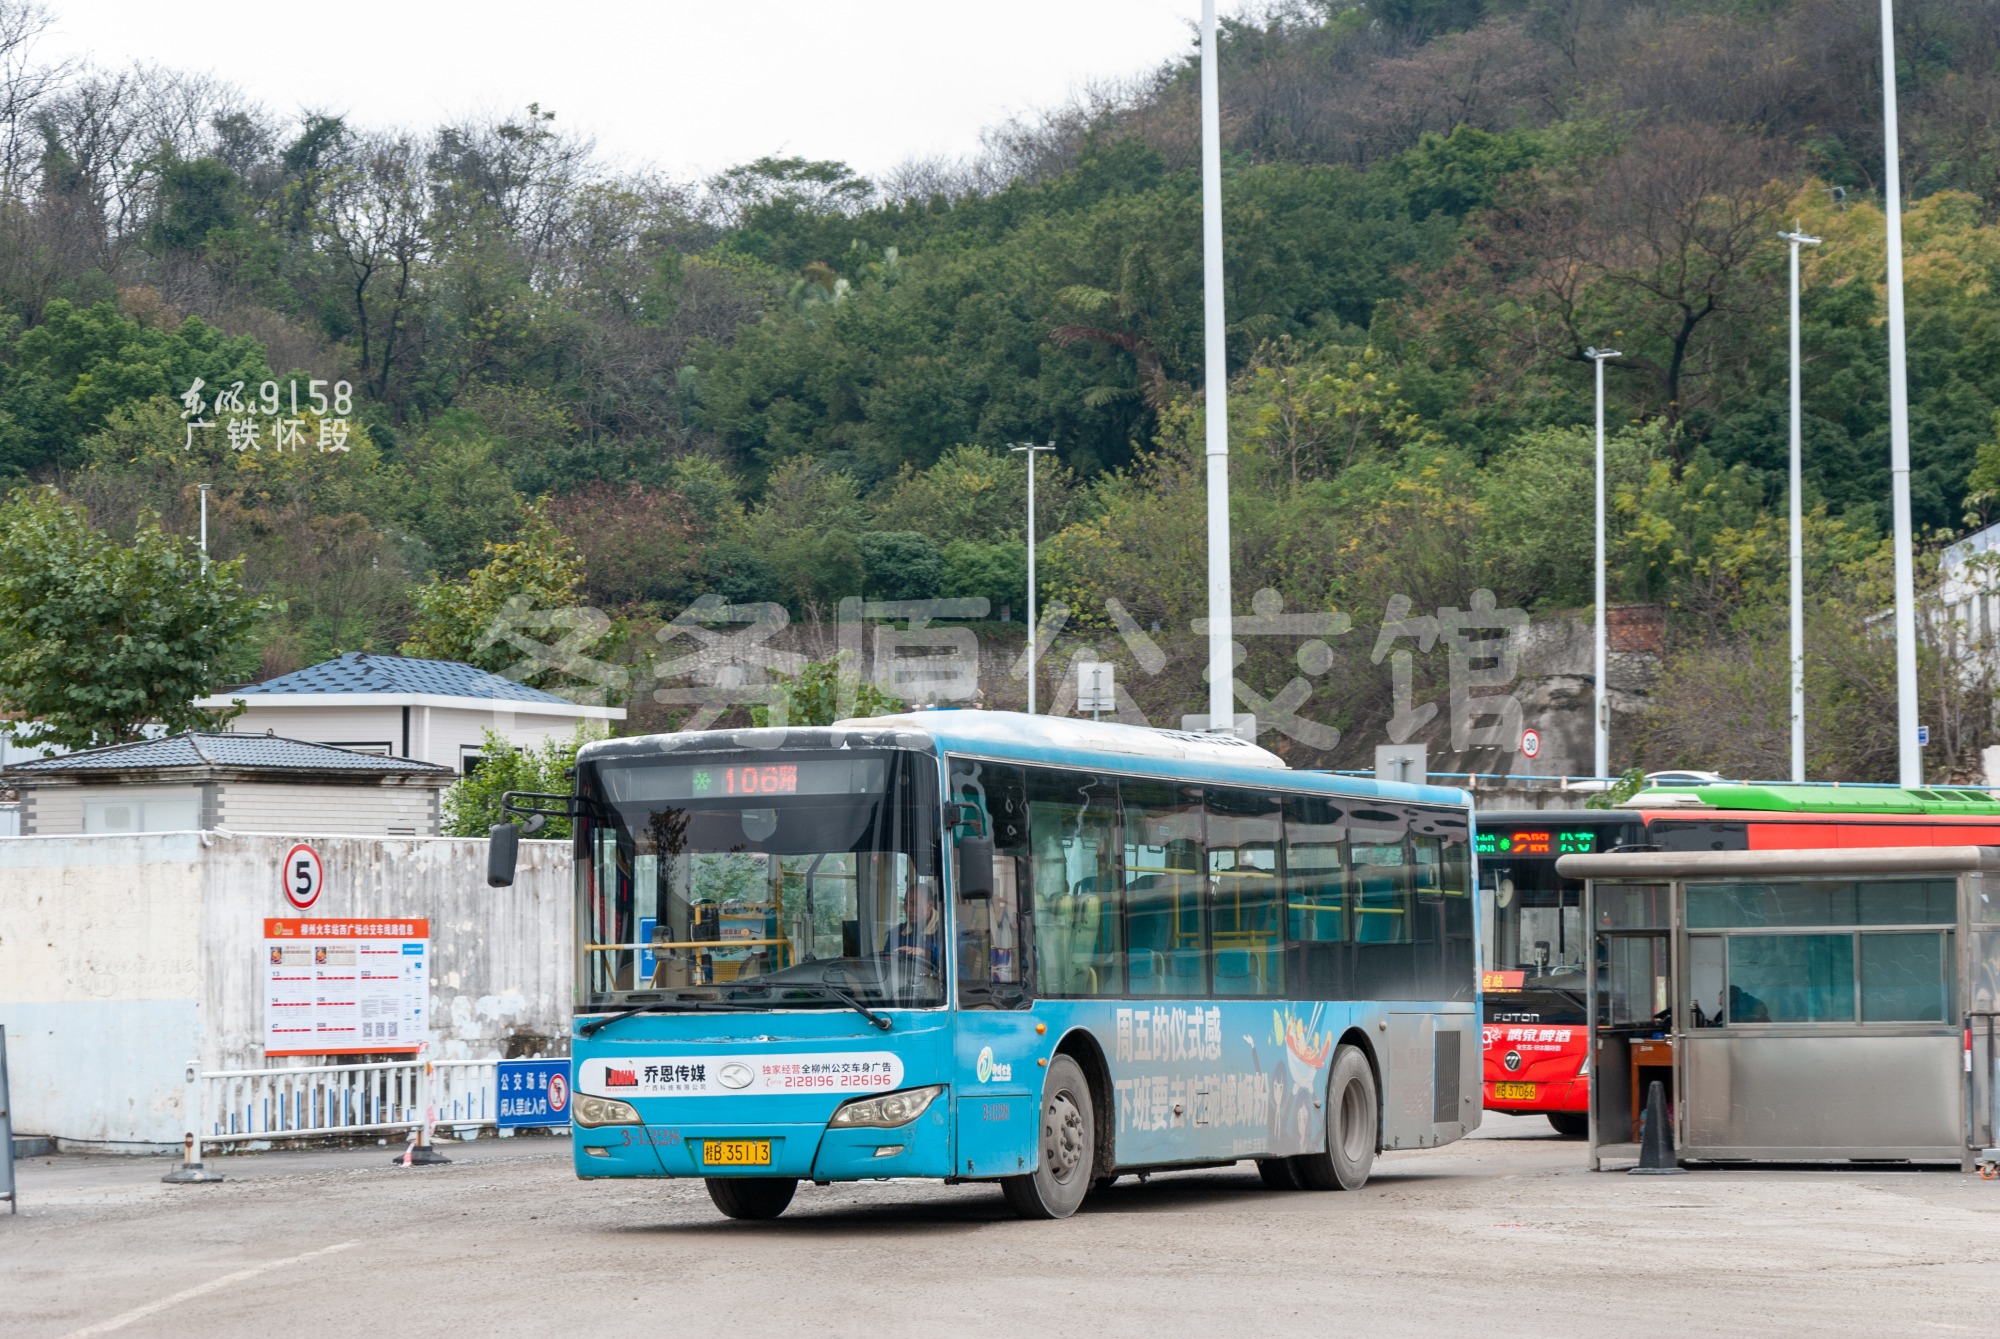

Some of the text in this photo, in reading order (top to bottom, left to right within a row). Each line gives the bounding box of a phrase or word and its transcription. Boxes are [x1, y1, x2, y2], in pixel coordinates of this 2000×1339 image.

[1526, 738, 1536, 751] 30
[724, 765, 798, 794] 106路
[295, 861, 312, 895] 5
[1493, 1013, 1540, 1022] FOTON
[1116, 1005, 1222, 1063] 周五的仪式感
[1507, 1028, 1573, 1043] 漓泉啤酒
[607, 1069, 636, 1086] JOHN
[644, 1064, 707, 1084] 乔恩传媒
[762, 1062, 892, 1076] 独家经营全柳州公交车身广告
[500, 1071, 548, 1091] 公交场站
[643, 1084, 707, 1092] 广西科技有限公司
[784, 1076, 834, 1087] 2128196
[840, 1074, 891, 1086] 2126196
[500, 1096, 548, 1117] 闲人禁止入内
[1114, 1072, 1270, 1133] 下班要去吃碗螺蛳粉
[620, 1127, 681, 1147] 3-1328
